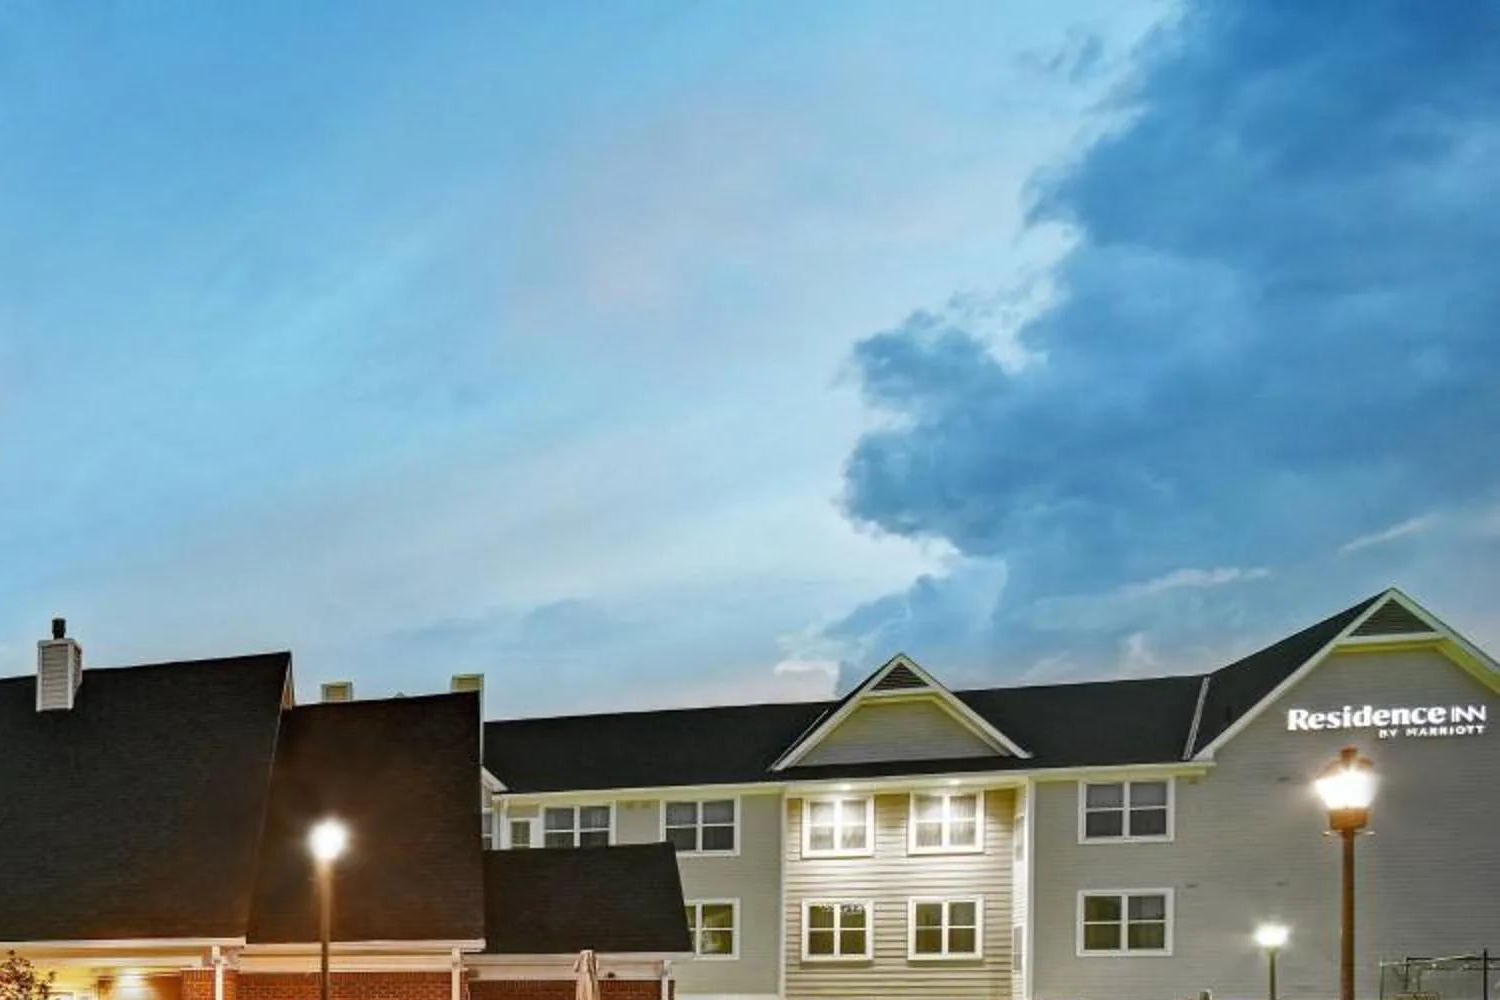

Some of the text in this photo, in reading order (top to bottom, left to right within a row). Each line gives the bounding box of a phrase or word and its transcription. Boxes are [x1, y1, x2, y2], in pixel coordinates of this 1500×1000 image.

[1287, 705, 1487, 731] Residence INN
[1379, 725, 1486, 739] BY MARRIOTT
